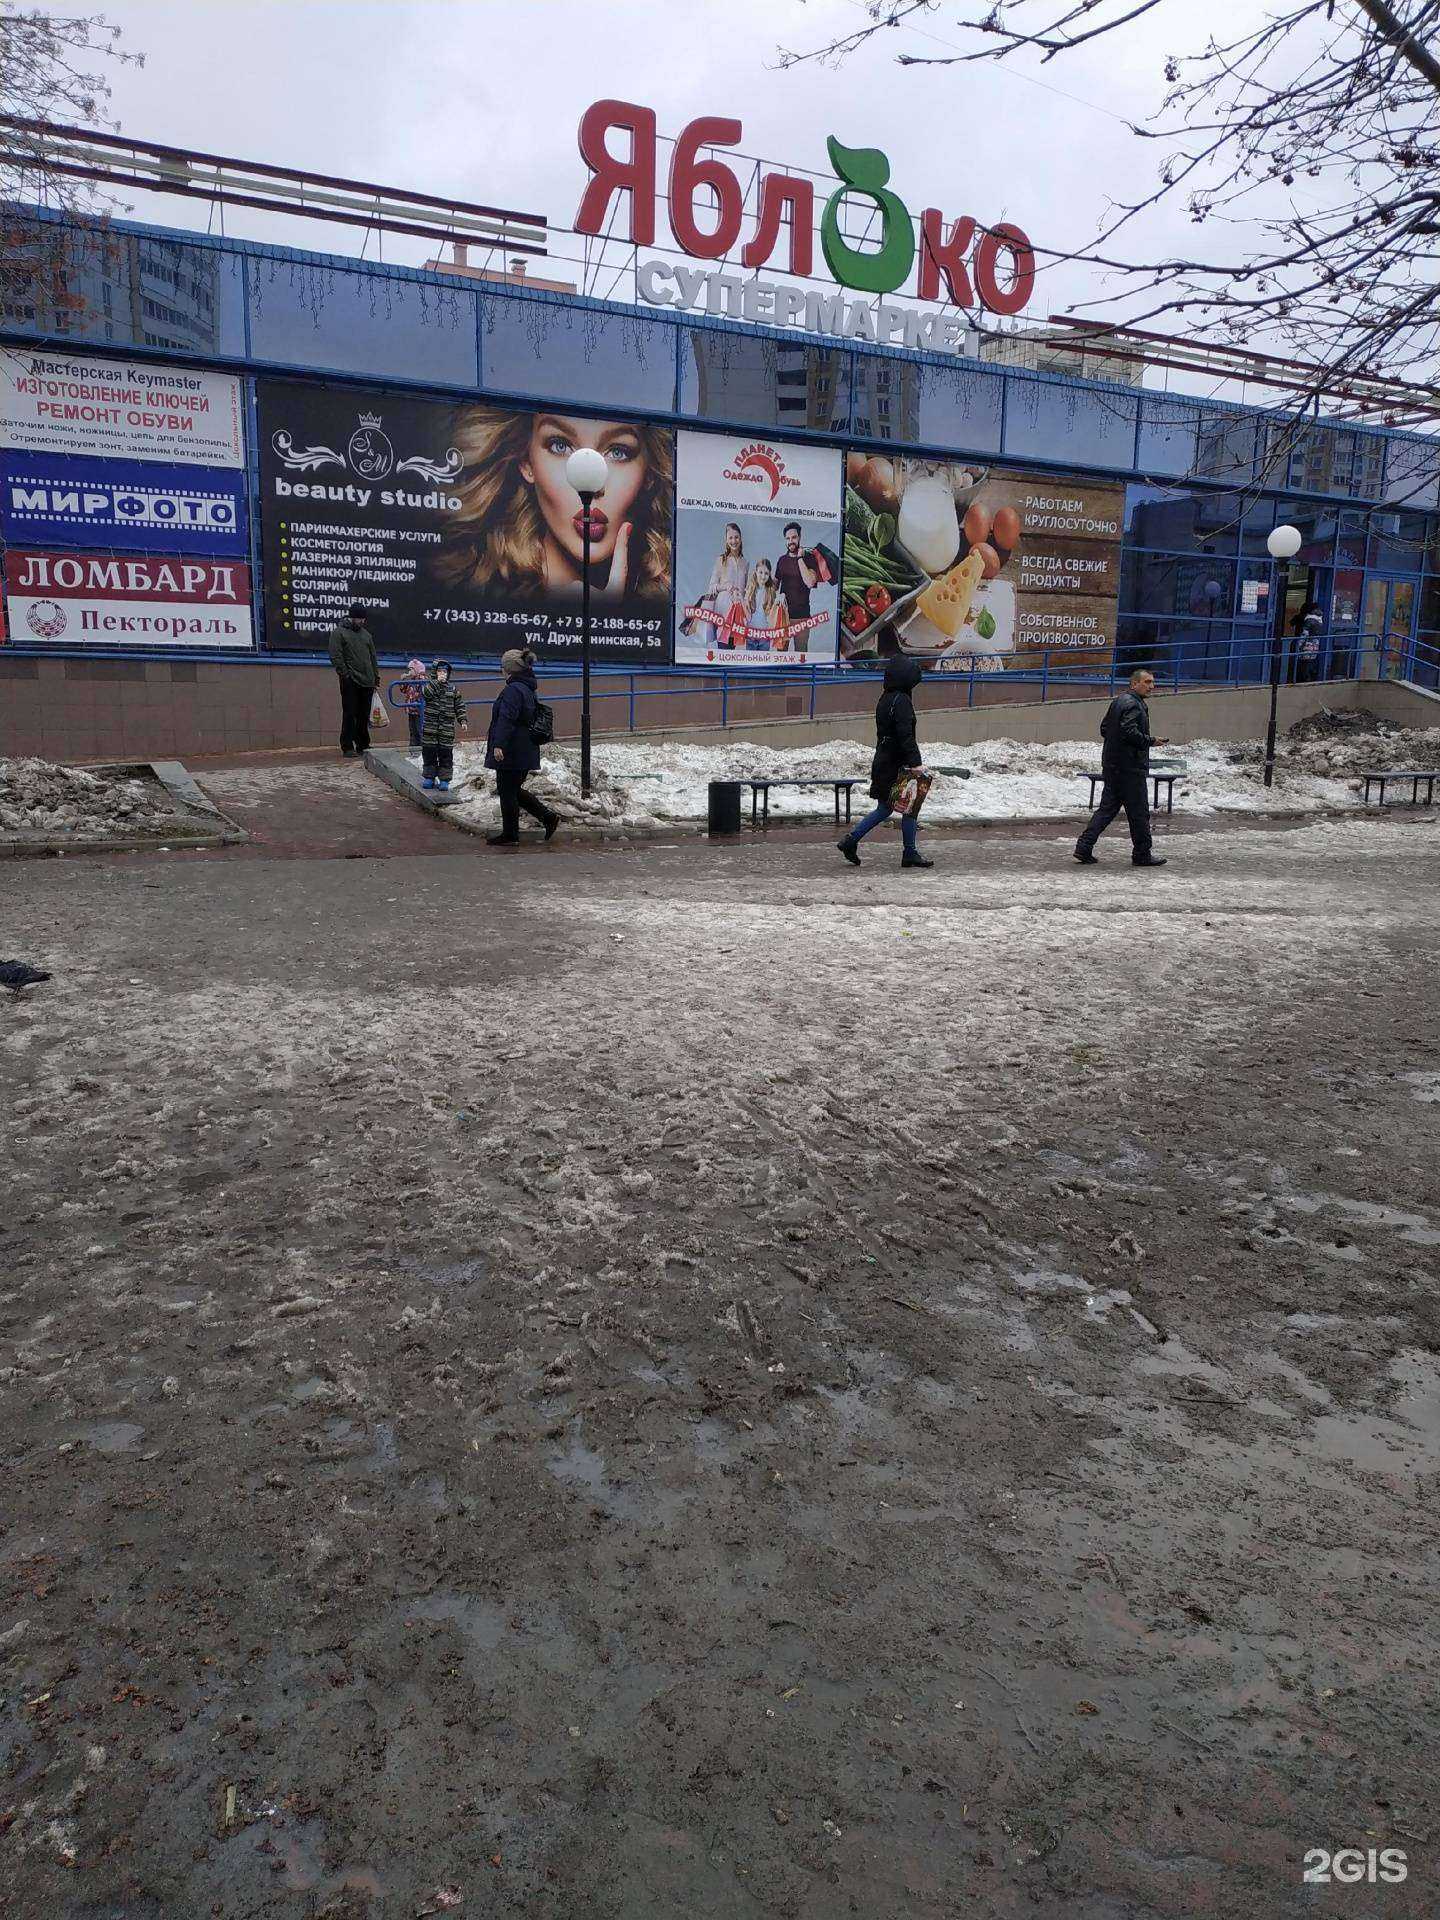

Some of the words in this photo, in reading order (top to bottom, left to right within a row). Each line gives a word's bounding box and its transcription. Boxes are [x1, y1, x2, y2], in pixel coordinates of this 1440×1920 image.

[637, 259, 987, 359] СУПЕРМАРКЕТ
[32, 358, 122, 382] Мастерская
[127, 366, 202, 391] Keymaster
[16, 376, 142, 406] ИЗГОТОВЛЕНИЕ
[146, 391, 210, 413] КЛЮЧЕЙ
[37, 401, 121, 424] РЕМОНТ
[127, 410, 193, 431] ОБУВИ
[1, 418, 45, 430] Заточим
[48, 423, 77, 434] ножи,
[80, 427, 128, 438] ножницы,
[10, 432, 96, 448] Отремонтируем
[127, 444, 170, 455] заменим
[733, 443, 787, 473] ПЛАНЕТА
[723, 469, 763, 483] Одежда
[275, 477, 372, 508] beauty
[380, 487, 463, 511] studio
[680, 497, 714, 508] ОДЕЖДА,
[715, 501, 739, 511] ОБУВЬ,
[740, 503, 783, 514] АКСЕССУАРЫ
[783, 507, 798, 516] ДЛЯ
[798, 507, 815, 517] ВСЕЙ
[1025, 496, 1083, 513] РАБОТАЕМ
[290, 522, 396, 540] ПАРИКМАХЕРСКИЕ
[399, 530, 442, 544] УСЛУГИ
[1024, 513, 1118, 533] КРУГЛОСУТОЧНО
[290, 537, 384, 553] КОСМЕТОЛОГИЯ
[291, 551, 351, 565] ЛАЗЕРНАЯ
[354, 556, 417, 569] ЭПИЛЯЦИЯ
[1022, 555, 1063, 571] ВСЕГДА
[1065, 558, 1108, 573] СВЕЖИЕ
[18, 556, 237, 601] ЛОМБАРД
[291, 565, 415, 582] МАНИКЮР/ПЕДИКЮР
[1021, 573, 1081, 588] ПРОДУКТЫ
[292, 580, 349, 592] СОЛЯРИЙ
[293, 606, 350, 619] ШУГАРИН
[423, 609, 441, 620] +7
[445, 610, 481, 625] (343)
[484, 611, 551, 628] 328-65-67,
[556, 616, 572, 628] +7
[575, 616, 662, 631] 92-188-65-67
[1019, 613, 1098, 629] СОБСТВЕННОЕ
[81, 610, 237, 638] Пектораль
[294, 620, 338, 632] ПИРСИ
[685, 607, 724, 626] МОДНО
[732, 623, 745, 635] НЕ
[747, 628, 785, 640] ЗНАЧИТ
[787, 612, 830, 637] ДОРОГО!
[525, 632, 544, 644] ул.
[548, 631, 643, 648] Дружнинская,
[647, 635, 661, 647] 5а
[1018, 631, 1106, 647] ПРОИЗВОДСТВО
[719, 652, 771, 664] ЦОКОЛЬНЫЙ
[773, 655, 796, 664] ЭТАЖ
